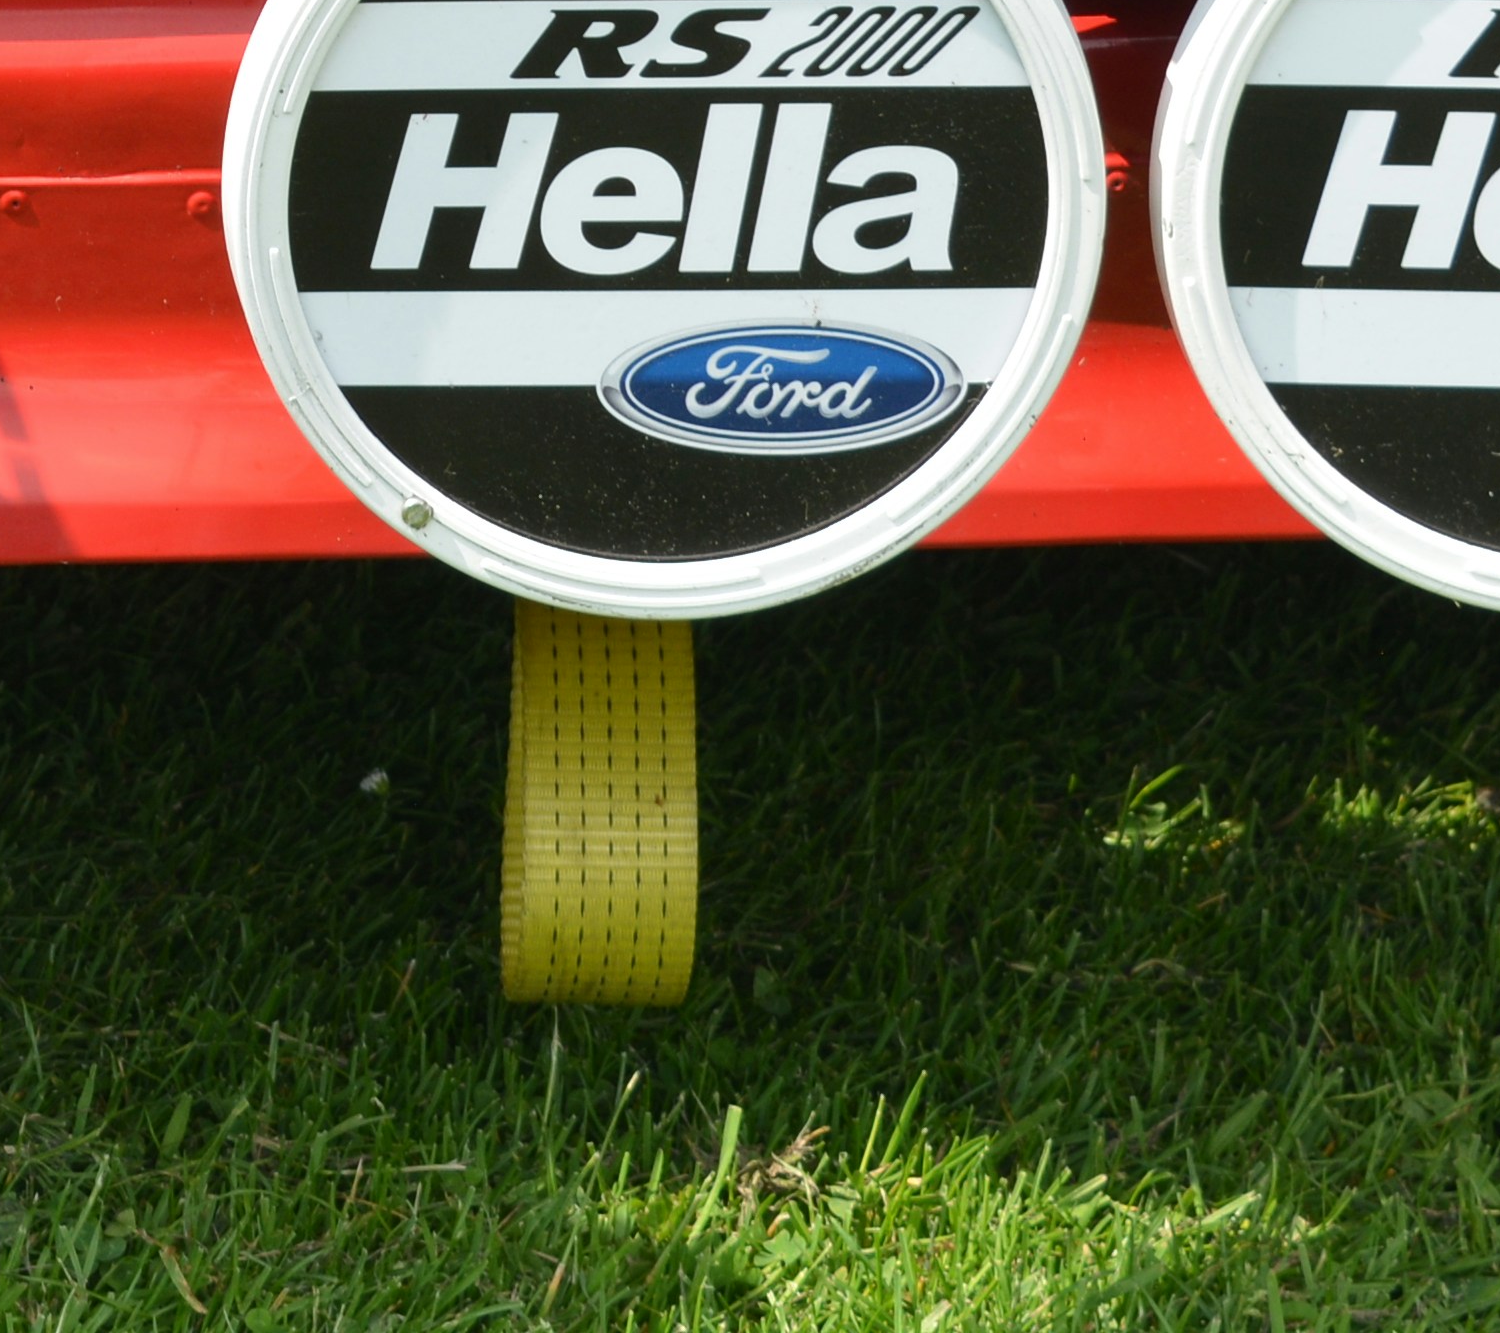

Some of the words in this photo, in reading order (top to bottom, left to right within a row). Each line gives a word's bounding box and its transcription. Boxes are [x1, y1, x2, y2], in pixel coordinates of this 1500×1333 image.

[510, 8, 772, 79] RS
[757, 6, 980, 78] 2000
[370, 103, 959, 275] Hella
[685, 344, 877, 419] Ford
